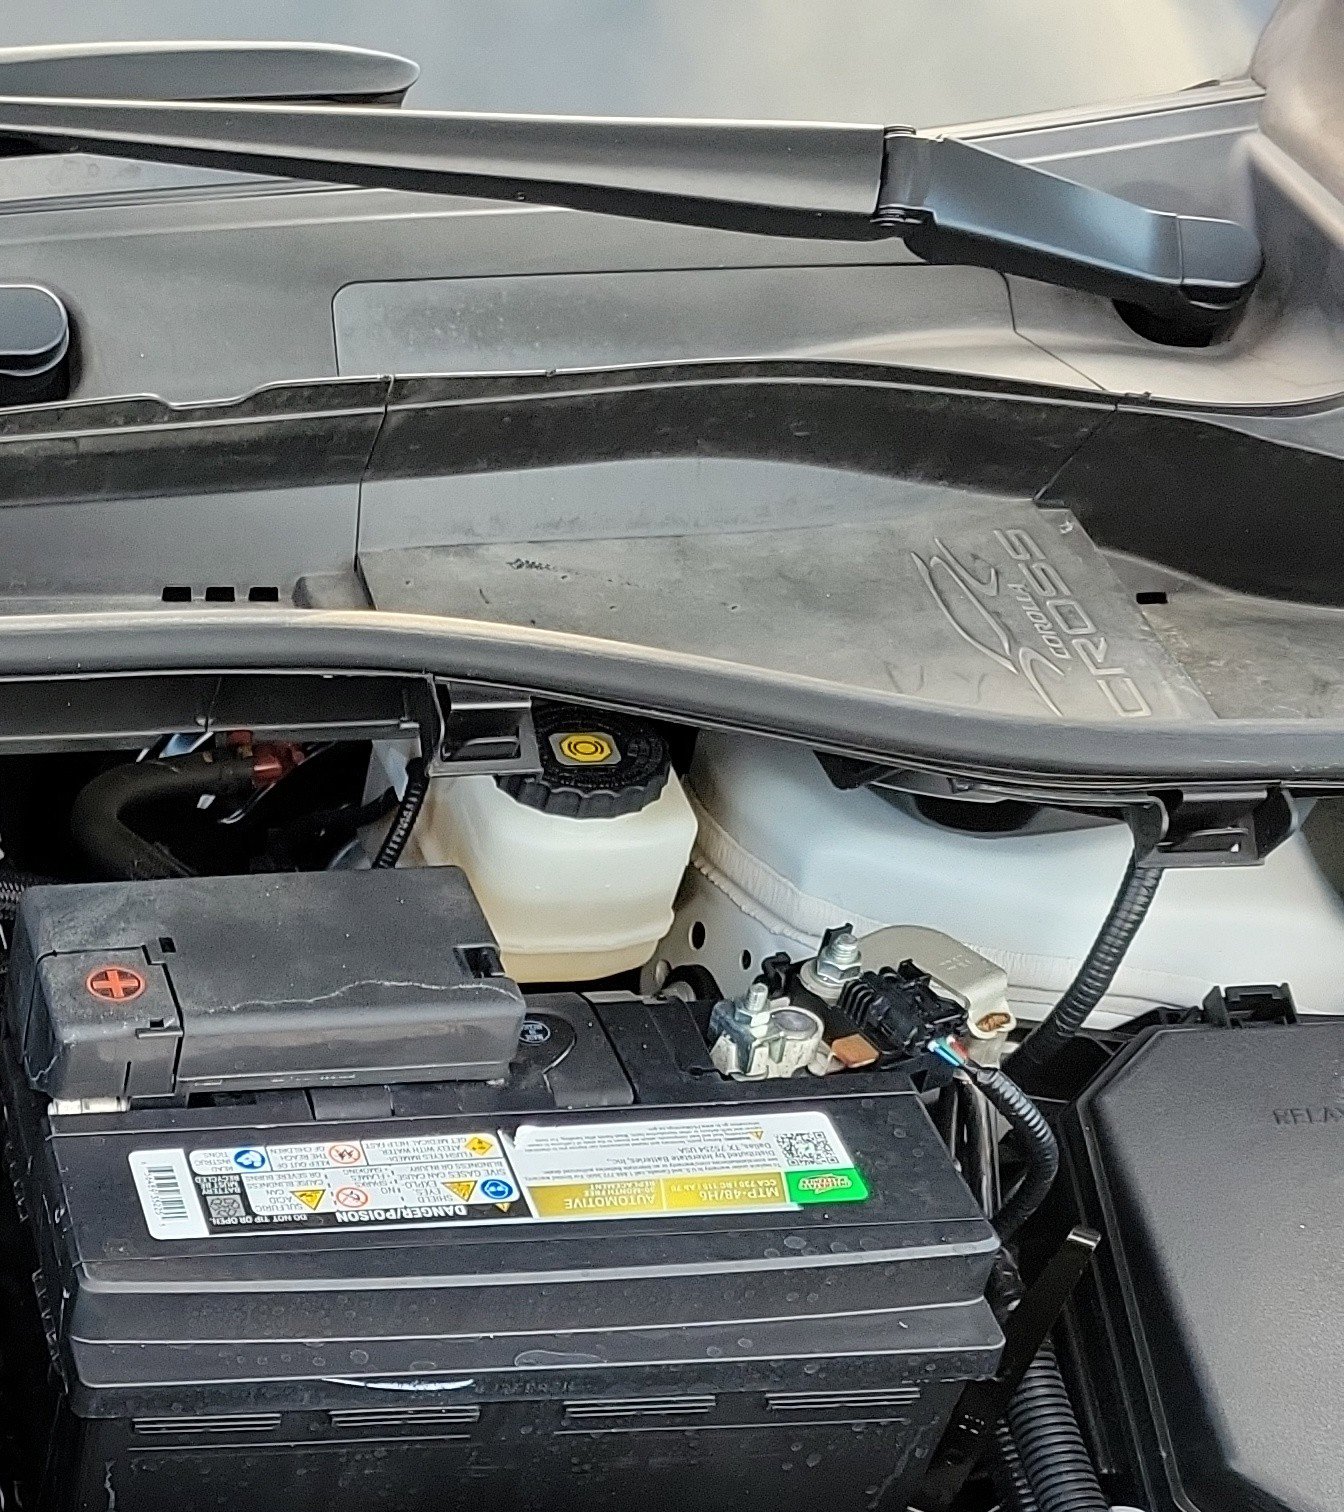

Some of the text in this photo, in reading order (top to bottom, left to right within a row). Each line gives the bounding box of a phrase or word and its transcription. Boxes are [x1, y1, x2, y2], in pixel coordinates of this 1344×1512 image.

[994, 528, 1152, 717] CROSS
[270, 1196, 293, 1204] ACID
[418, 1195, 453, 1204] SHIELD
[564, 1194, 656, 1209] AUTOMOTIVE
[255, 1203, 304, 1213] SULFURIC
[335, 1205, 468, 1223] DANGER/POISON
